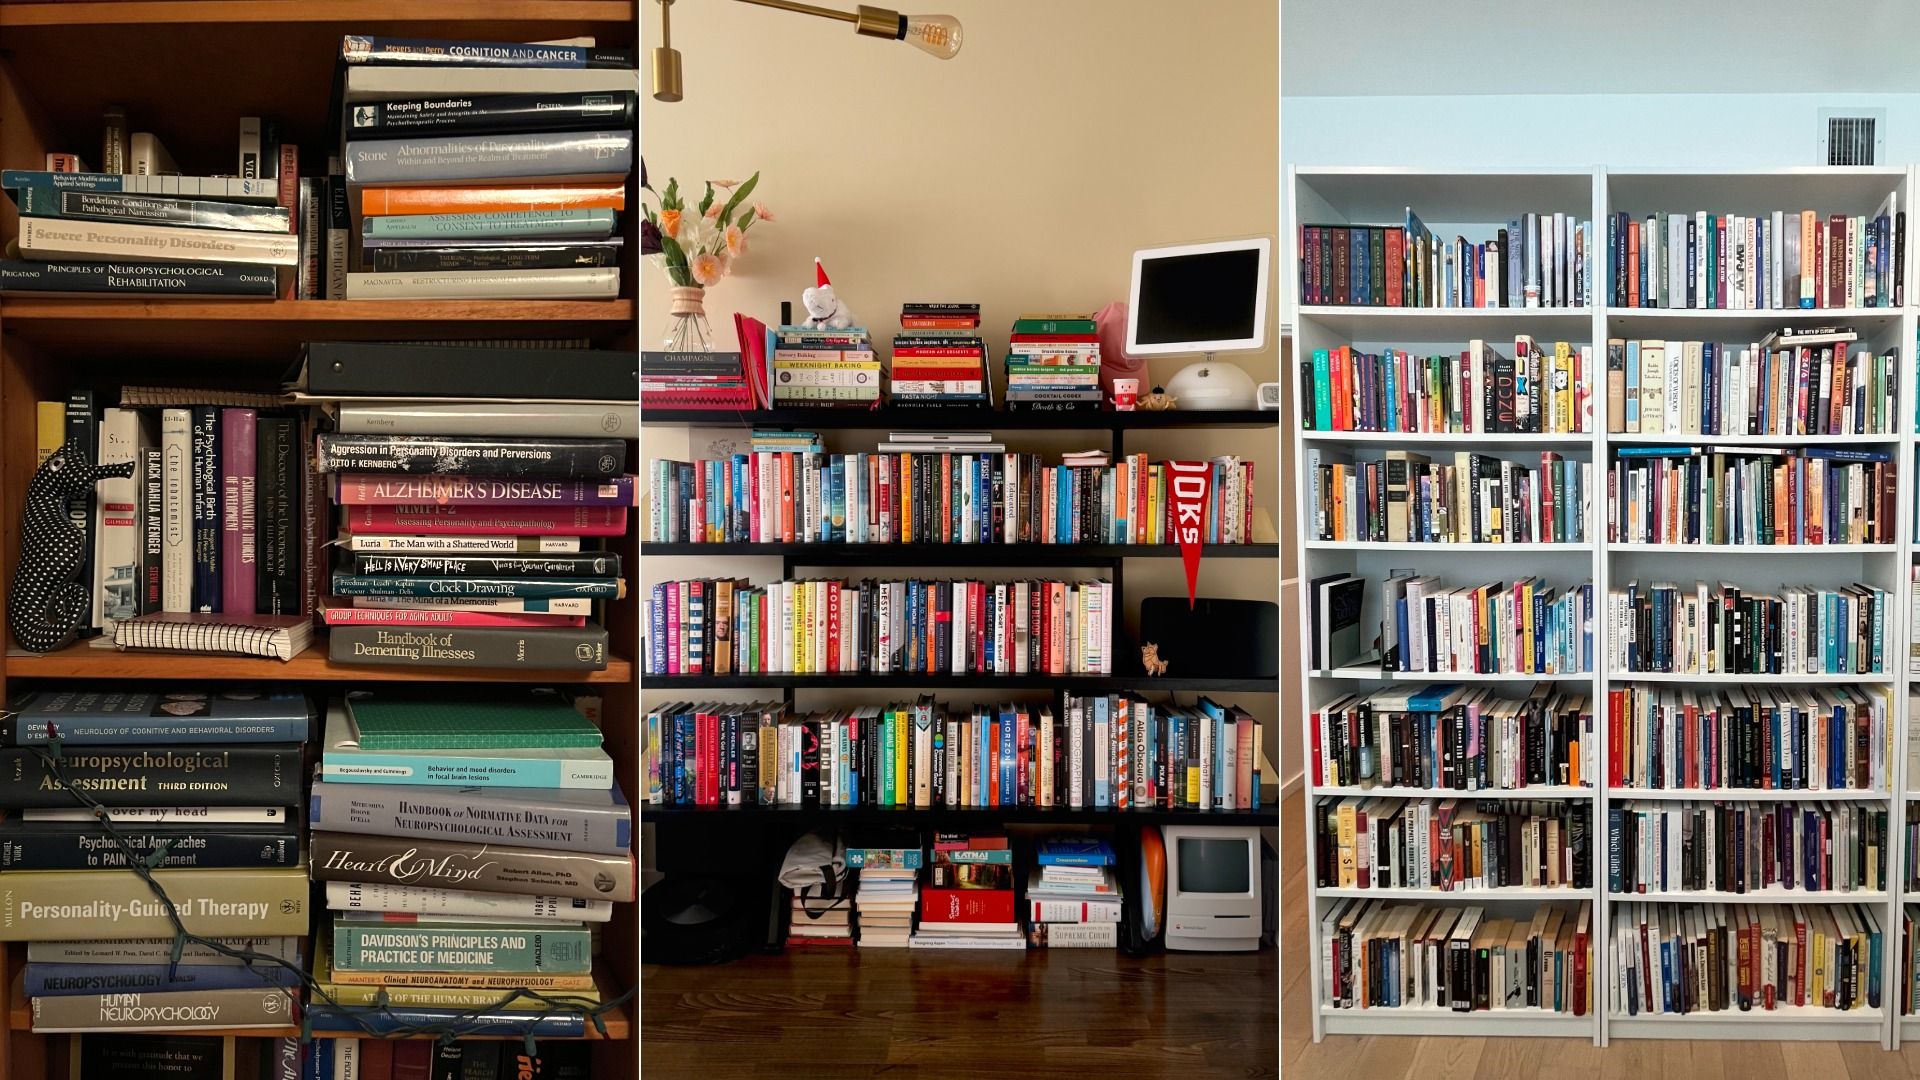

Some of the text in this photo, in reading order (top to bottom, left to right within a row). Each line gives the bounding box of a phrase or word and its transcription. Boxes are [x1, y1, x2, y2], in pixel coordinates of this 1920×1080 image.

[450, 46, 577, 61] COGNITION AND CANCER
[387, 100, 472, 113] Keeping Boundaries
[358, 151, 388, 162] Stone
[35, 229, 236, 251] Severe Personality Disorders
[2, 265, 269, 282] PRIGATANO PRINCIPLES OF NEUROPSYCHOLOGICAL OXFORD
[107, 275, 186, 288] REHABILITATION
[664, 354, 715, 362] CHAMPAGNE
[1801, 357, 1809, 378] 24/6
[330, 443, 552, 460] Aggression in Personality Disorders and Perversions
[194, 425, 204, 519] of the Human Infant
[202, 412, 216, 520] The Psychological Birth
[330, 459, 397, 469] OTTO F. KERNBERG
[170, 455, 179, 537] the lobotomist
[374, 482, 562, 500] ALZHEIMER'S DISEASE
[1554, 484, 1562, 508] linger
[148, 451, 161, 554] BLACK DAHLIA AVENGER
[225, 476, 239, 531] OF DEVELOPMENT
[241, 476, 255, 563] PSYCHOANALYTIC THEORIES
[360, 539, 381, 548] Luria
[389, 540, 404, 548] The
[406, 540, 424, 548] Man
[426, 539, 444, 548] with
[452, 539, 489, 549] Shattered
[491, 539, 514, 549] World
[429, 581, 515, 596] Clock Drawing
[830, 585, 838, 639] RODHAM
[1031, 591, 1040, 636] BAD BLOOD
[377, 631, 453, 647] Handbook of
[354, 644, 475, 660] Dementing Illnesses
[74, 727, 118, 735] NEUROLOGY
[119, 727, 130, 735] OF
[132, 726, 170, 734] COGNITIVE
[172, 726, 187, 734] AND
[189, 726, 234, 734] BEHAVIORAL
[236, 725, 275, 733] DISORDERS
[1073, 714, 1081, 789] PHOTOGRAPHY
[1137, 719, 1145, 783] Atlas Obscura
[427, 765, 455, 773] Behavior
[488, 766, 516, 774] disorders
[1201, 757, 1209, 774] what
[40, 775, 228, 791] Asessment THIRD EDITION
[112, 806, 208, 822] over my head
[399, 801, 451, 818] HANDBOOK
[466, 806, 522, 823] NORMATIVE
[524, 810, 549, 825] DATA
[552, 818, 568, 827] FOR
[394, 816, 573, 842] NEUROPSYCHOLOGICAL ASSESSMENT
[1611, 828, 1620, 877] Which Lilith?
[322, 848, 499, 882] Heart & Mind
[197, 898, 269, 920] Therapy
[361, 934, 526, 949] DAVIDSON'S PRINCIPLES AND
[1054, 931, 1110, 940] SUPREME COURT
[361, 950, 494, 965] PRACTICE OF MEDICINE
[43, 974, 162, 991] NEUROPSYCHOLOGY
[383, 975, 554, 987] Clinical NEUROANATOMY and NEUROPHYSIOLOGY
[100, 993, 141, 1006] HUMAN
[100, 1005, 219, 1021] NEUROPSYCHOLOGY
